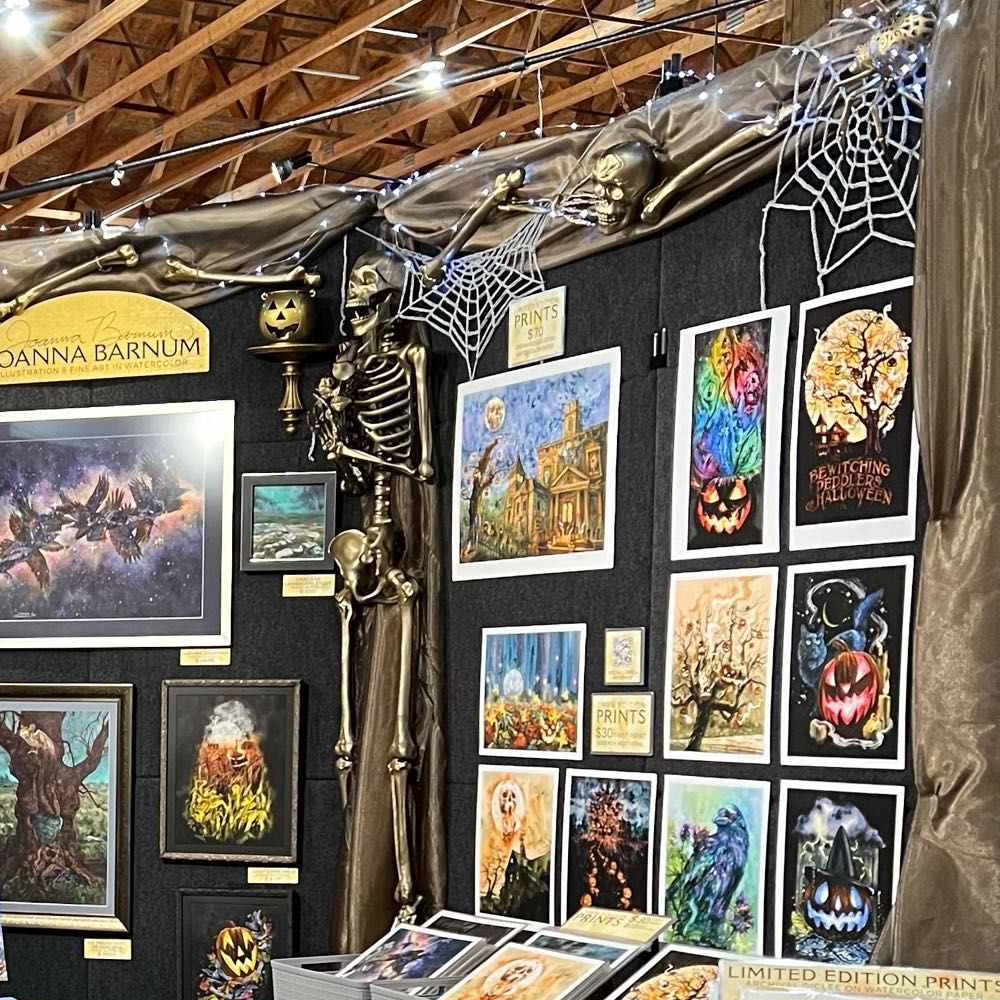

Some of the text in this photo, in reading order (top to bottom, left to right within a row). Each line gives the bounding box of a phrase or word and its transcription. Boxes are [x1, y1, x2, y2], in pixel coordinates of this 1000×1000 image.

[514, 303, 558, 328] PRINTS
[528, 327, 544, 340] $70
[94, 337, 201, 362] BARNUM
[69, 364, 91, 374] FINE
[92, 363, 111, 373] ART
[112, 363, 123, 371] IN
[124, 358, 188, 371] WATERCOLOR
[808, 459, 891, 482] BEWITCHING
[816, 473, 882, 491] PEDDLERS
[596, 709, 646, 725] PRINTS
[595, 727, 613, 739] $30
[573, 913, 625, 927] PRINTS
[728, 965, 1000, 994] LIMITED EDITION PRINTS
[844, 985, 861, 993] ON
[865, 986, 943, 999] WATERCOLOR
[946, 991, 984, 1000] PAPER
